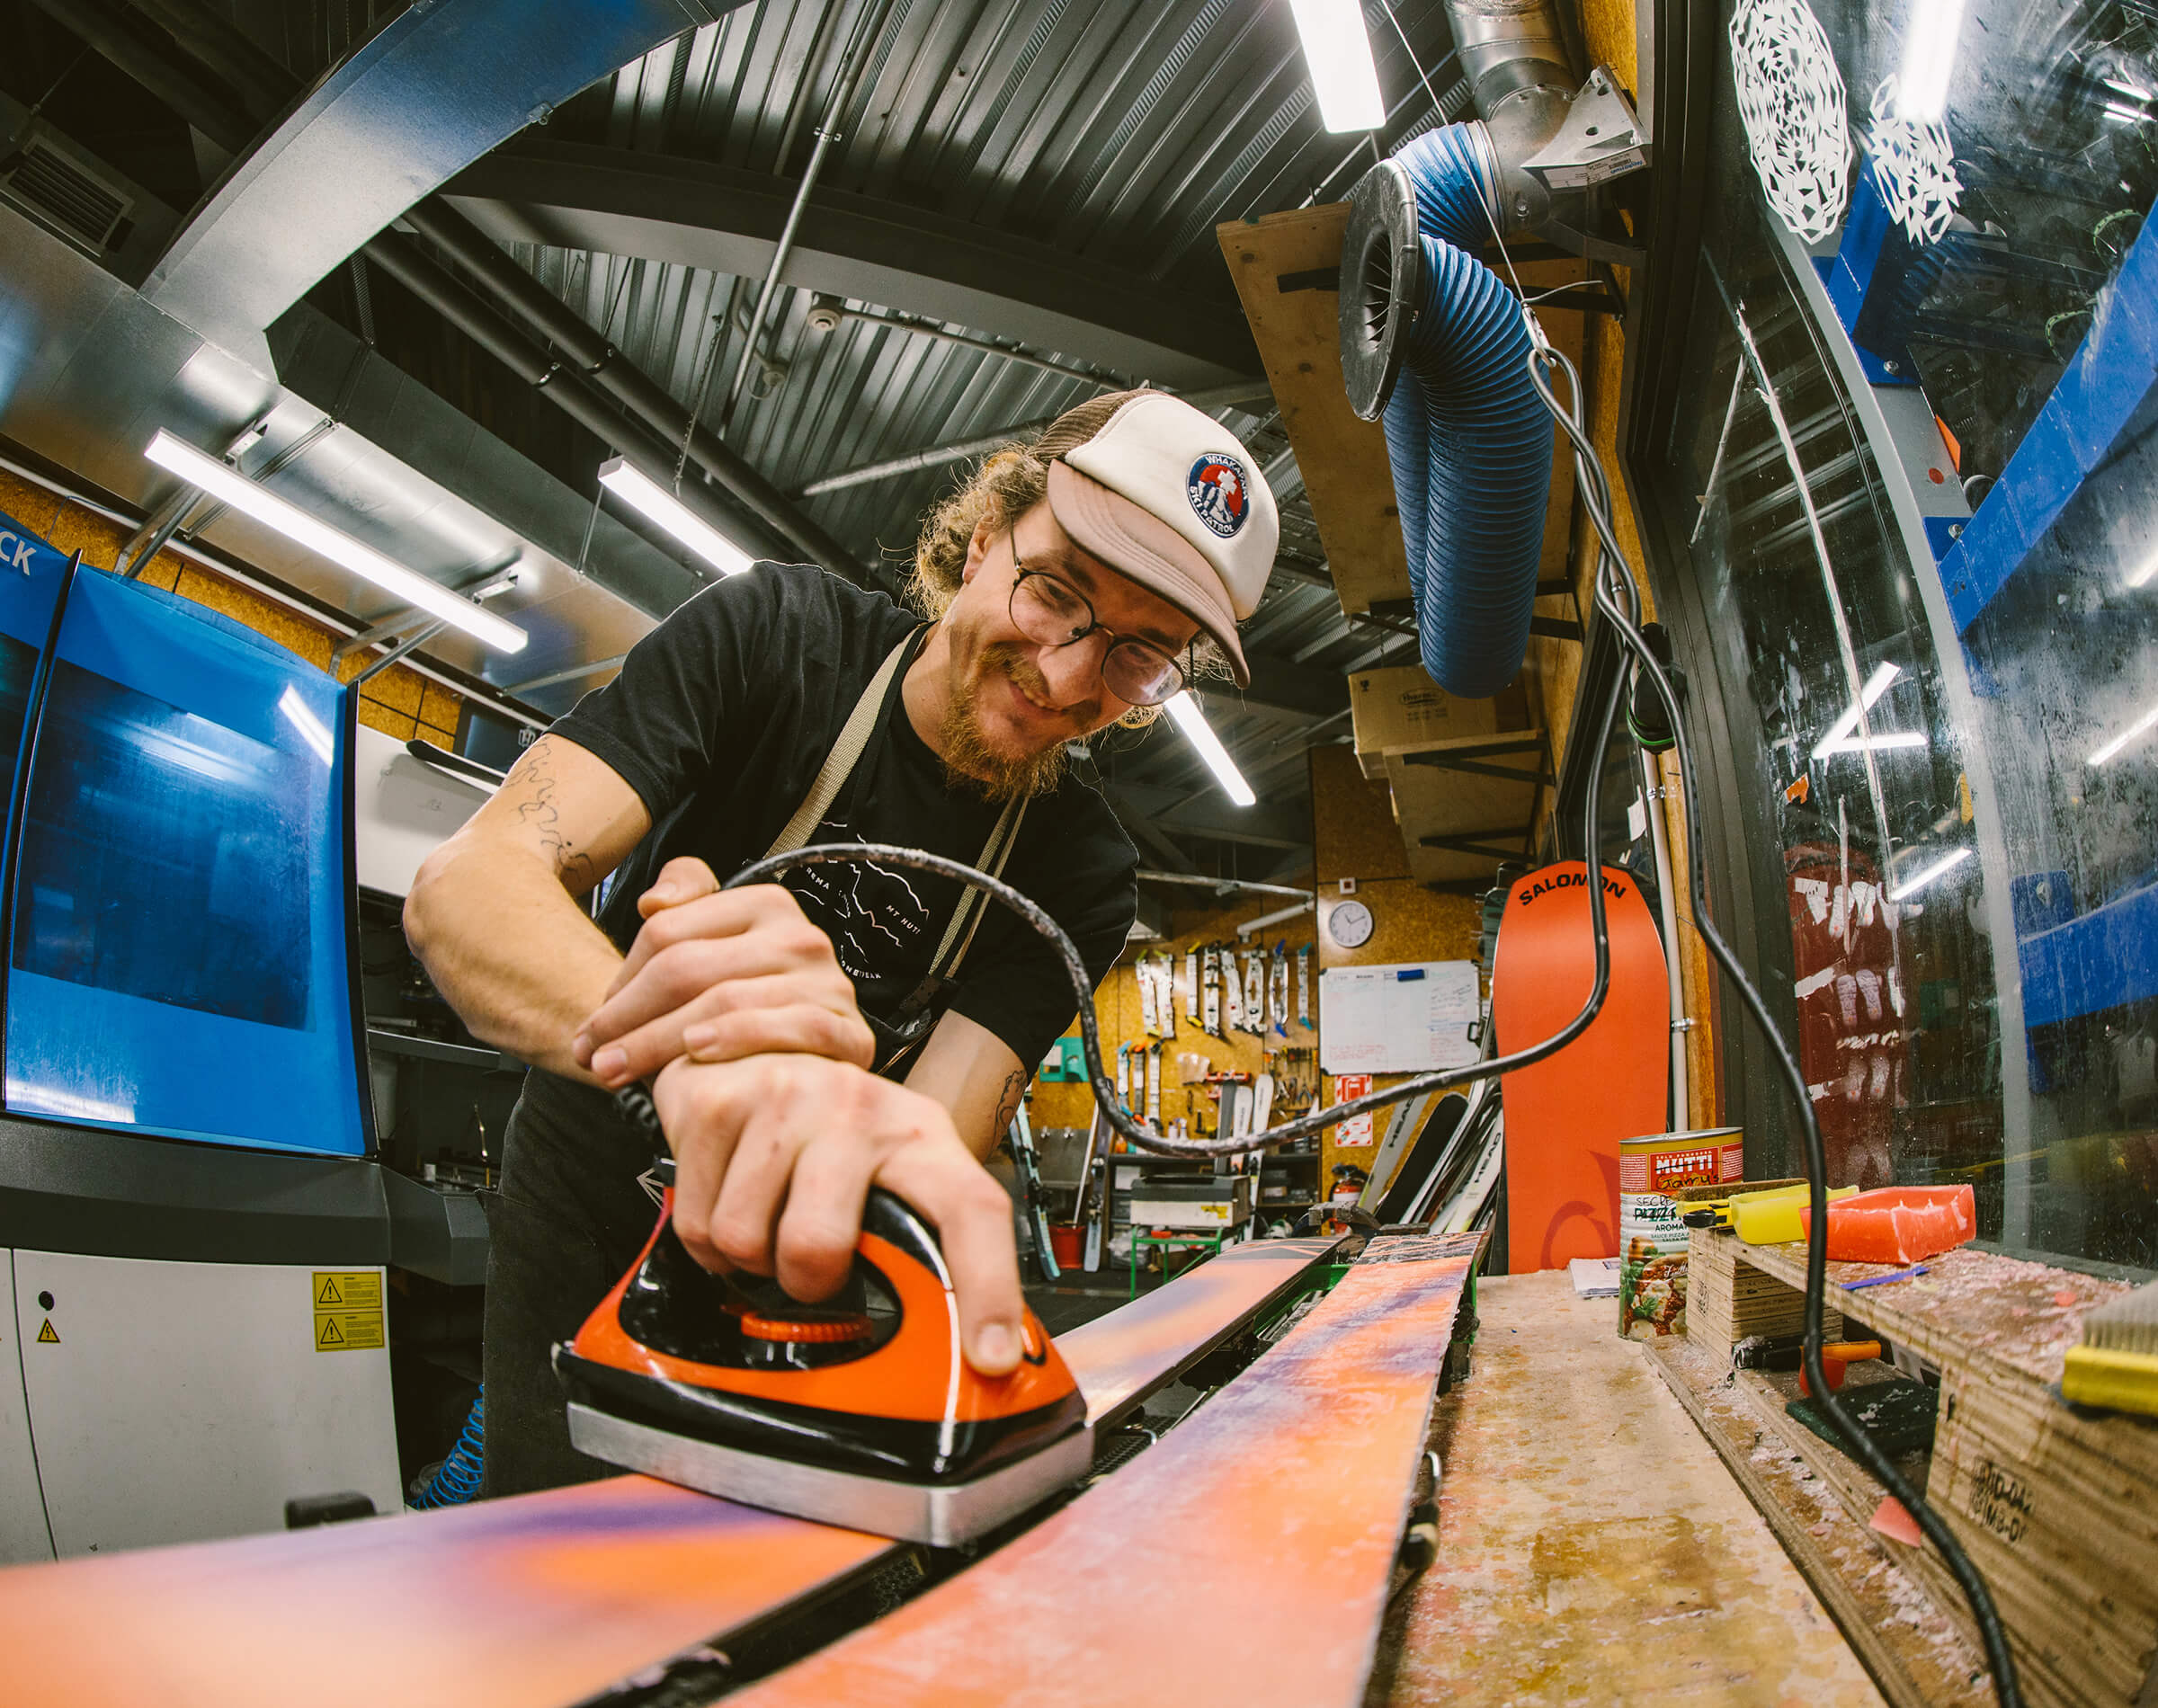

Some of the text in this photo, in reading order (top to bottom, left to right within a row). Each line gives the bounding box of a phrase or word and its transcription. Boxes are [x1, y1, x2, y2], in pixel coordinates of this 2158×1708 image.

[1189, 485, 1235, 534] SKI PATROL
[886, 904, 900, 917] MT
[1475, 1133, 1502, 1183] HEAD
[1656, 1154, 1713, 1175] MUTTI
[1636, 1195, 1677, 1206] SECRE
